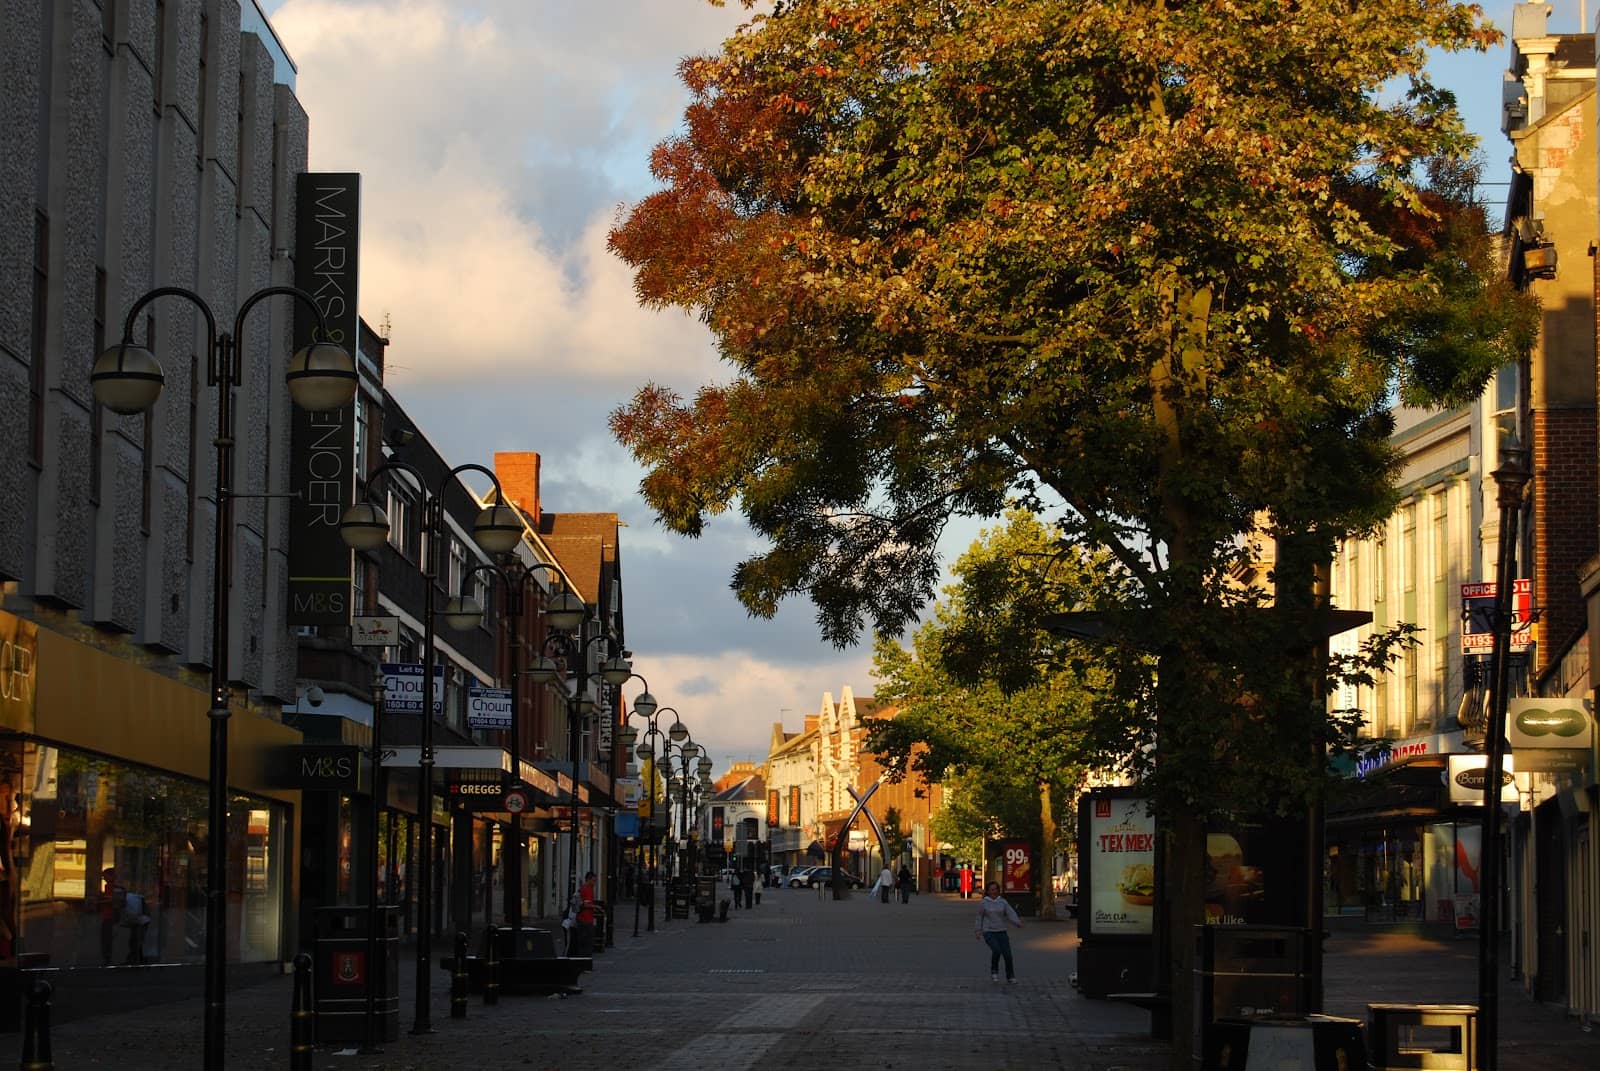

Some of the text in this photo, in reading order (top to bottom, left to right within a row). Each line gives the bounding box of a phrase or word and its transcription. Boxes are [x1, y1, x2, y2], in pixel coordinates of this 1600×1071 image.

[313, 186, 346, 319] MARKS
[308, 407, 344, 528] ENCER
[293, 592, 344, 614] M&S
[472, 698, 512, 712] Chown
[301, 756, 352, 778] M&S
[459, 784, 502, 795] GREGGS
[1100, 833, 1153, 852] TEX MEX
[1223, 913, 1245, 926] like
